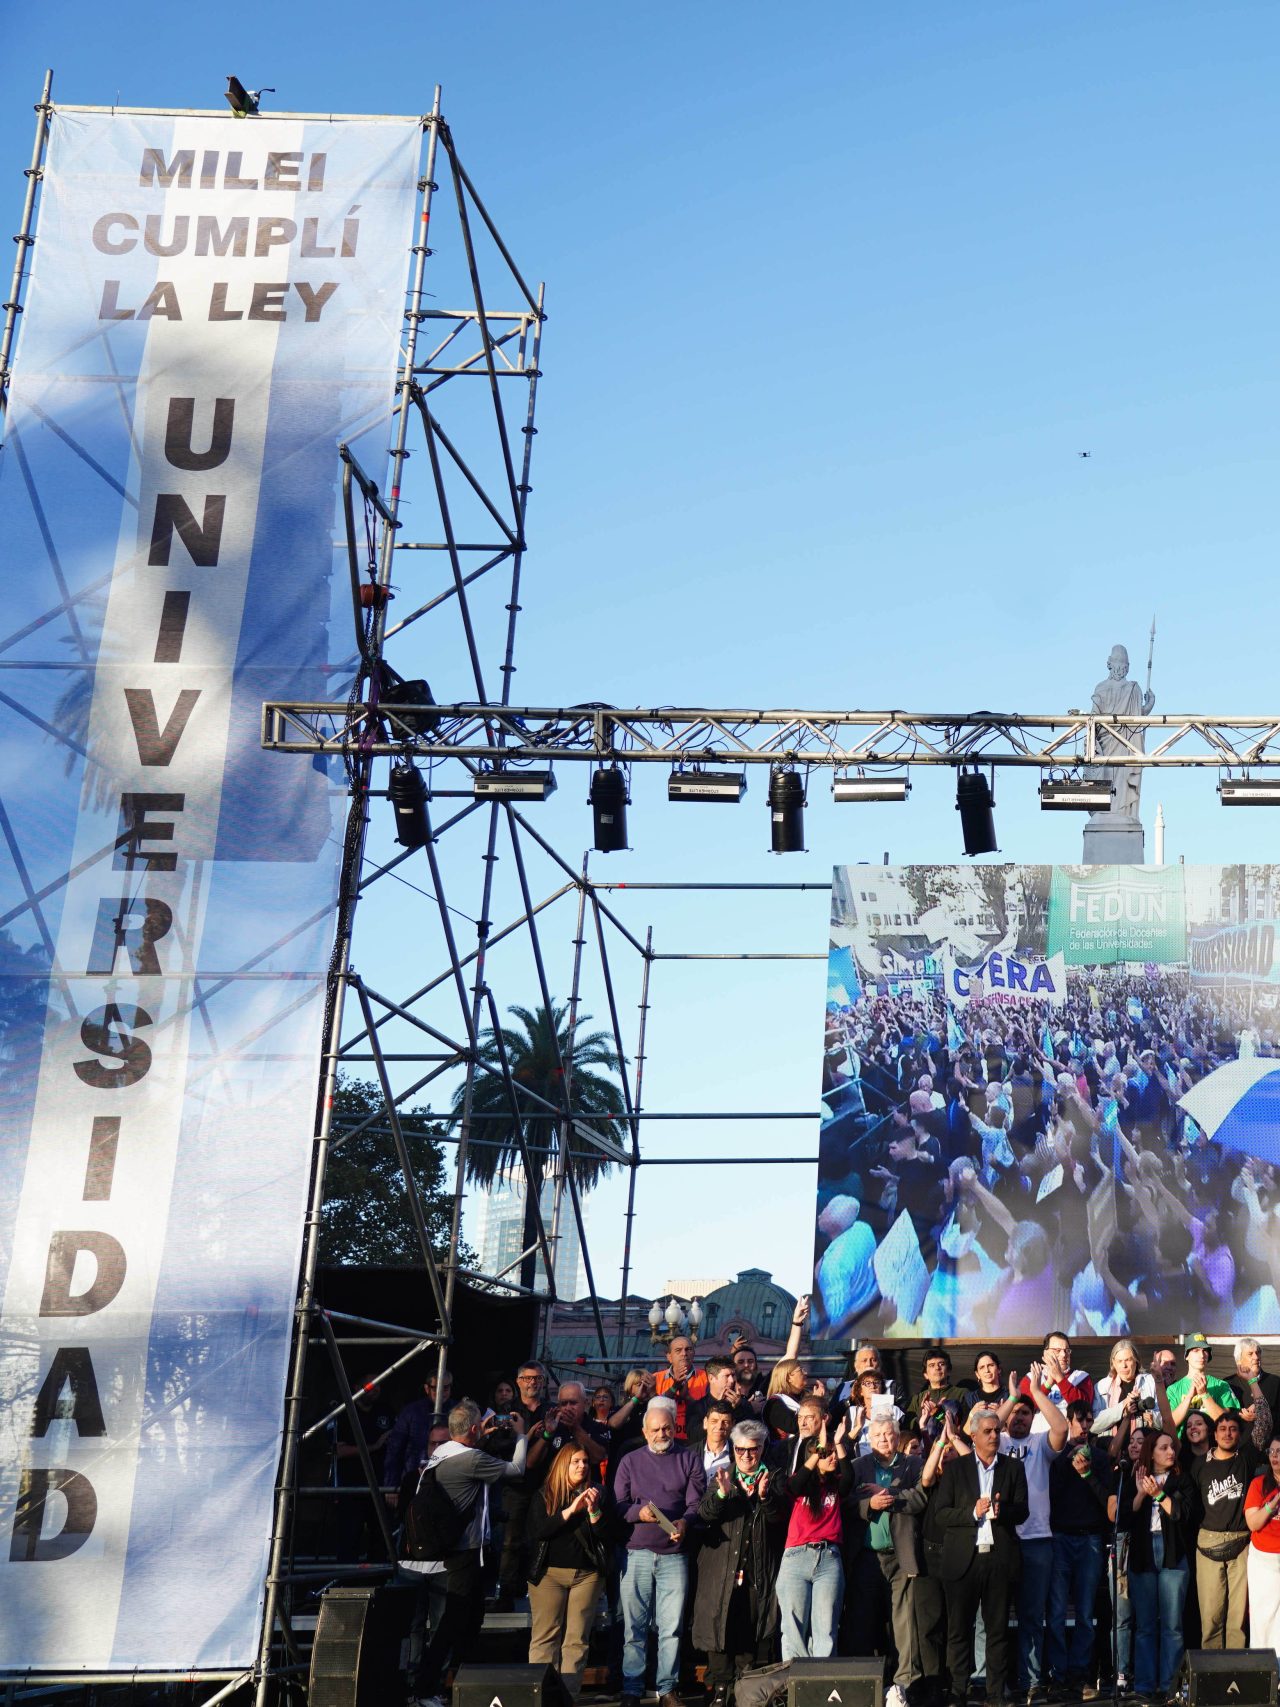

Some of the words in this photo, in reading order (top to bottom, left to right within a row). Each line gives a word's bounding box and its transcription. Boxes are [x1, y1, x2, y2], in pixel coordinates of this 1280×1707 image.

[139, 148, 327, 192] MILEI
[92, 205, 362, 258] CUMPLÍ
[99, 280, 182, 321] LA
[207, 281, 340, 323] LEY
[1069, 882, 1167, 922] FEDUN
[9, 397, 235, 1562] UNIVERSIDAD
